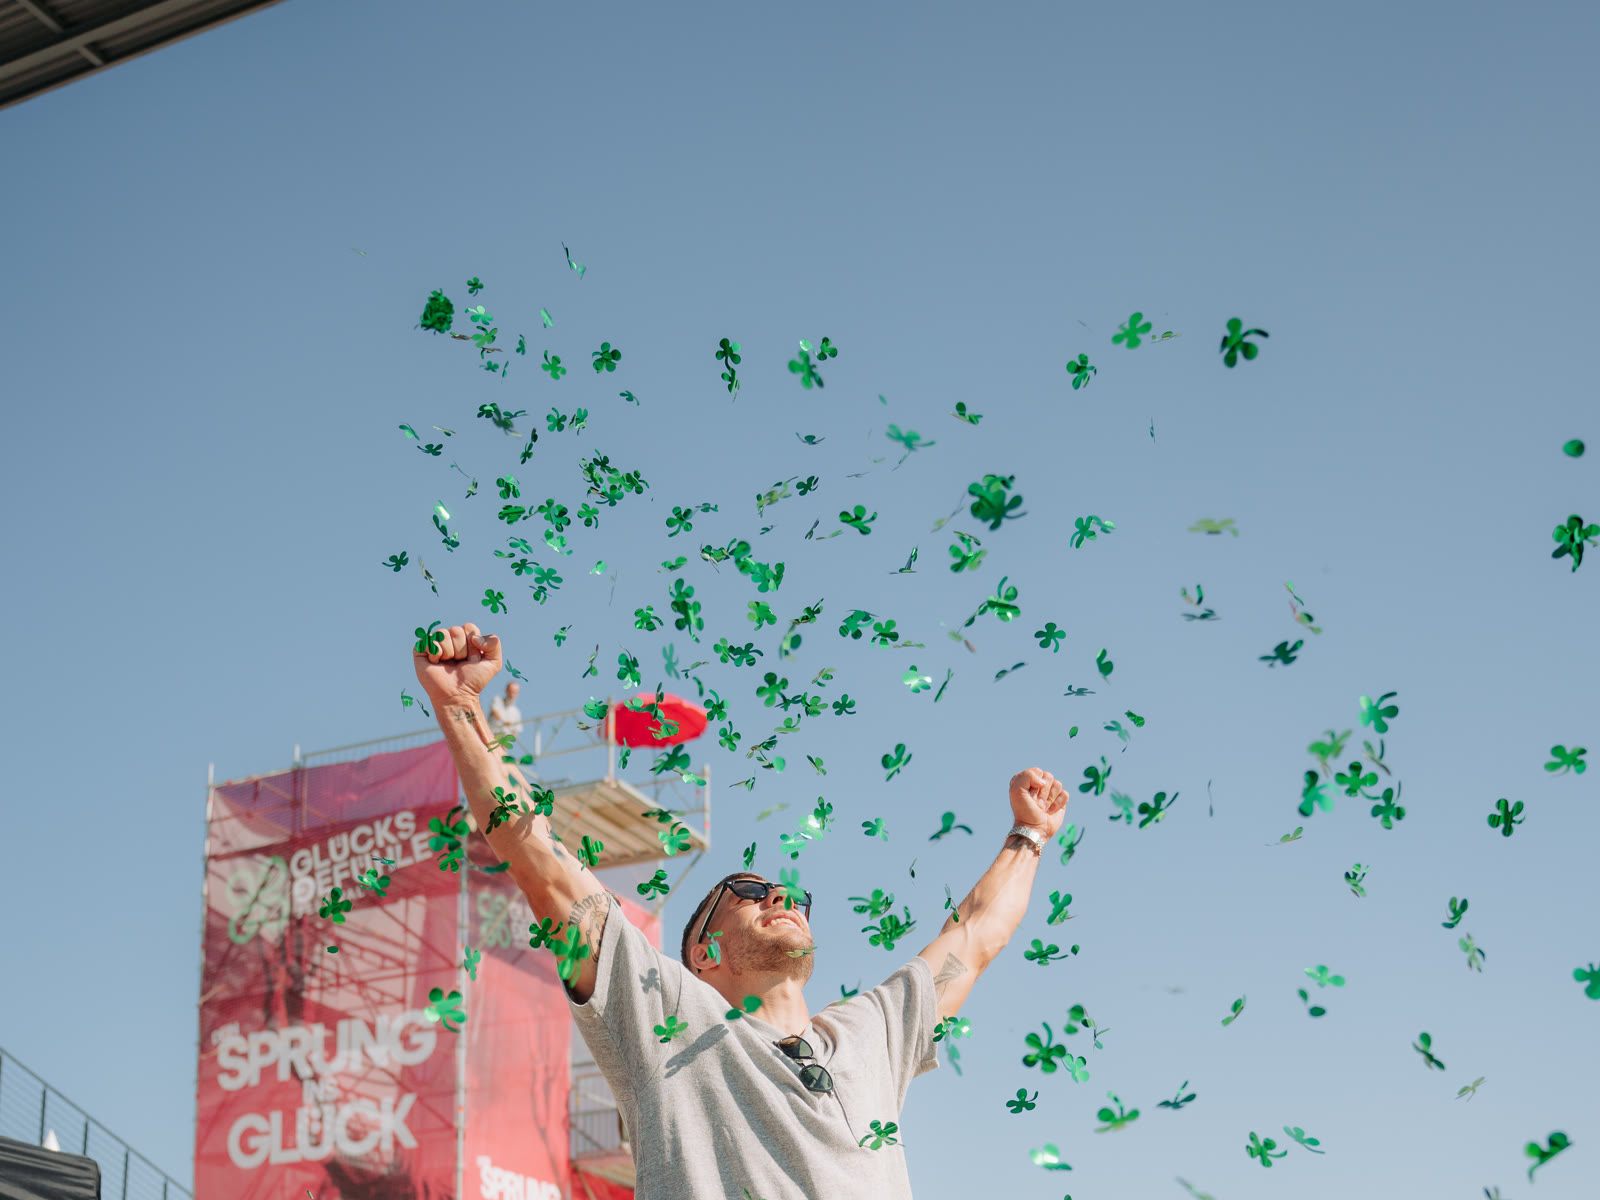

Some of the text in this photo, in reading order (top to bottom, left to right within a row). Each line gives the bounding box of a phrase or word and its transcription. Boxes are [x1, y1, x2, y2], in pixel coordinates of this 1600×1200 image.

[290, 811, 416, 879] GLÜCKS
[216, 1009, 437, 1091] SPRUNG
[302, 1077, 339, 1104] INS
[227, 1093, 418, 1169] GLÜCK
